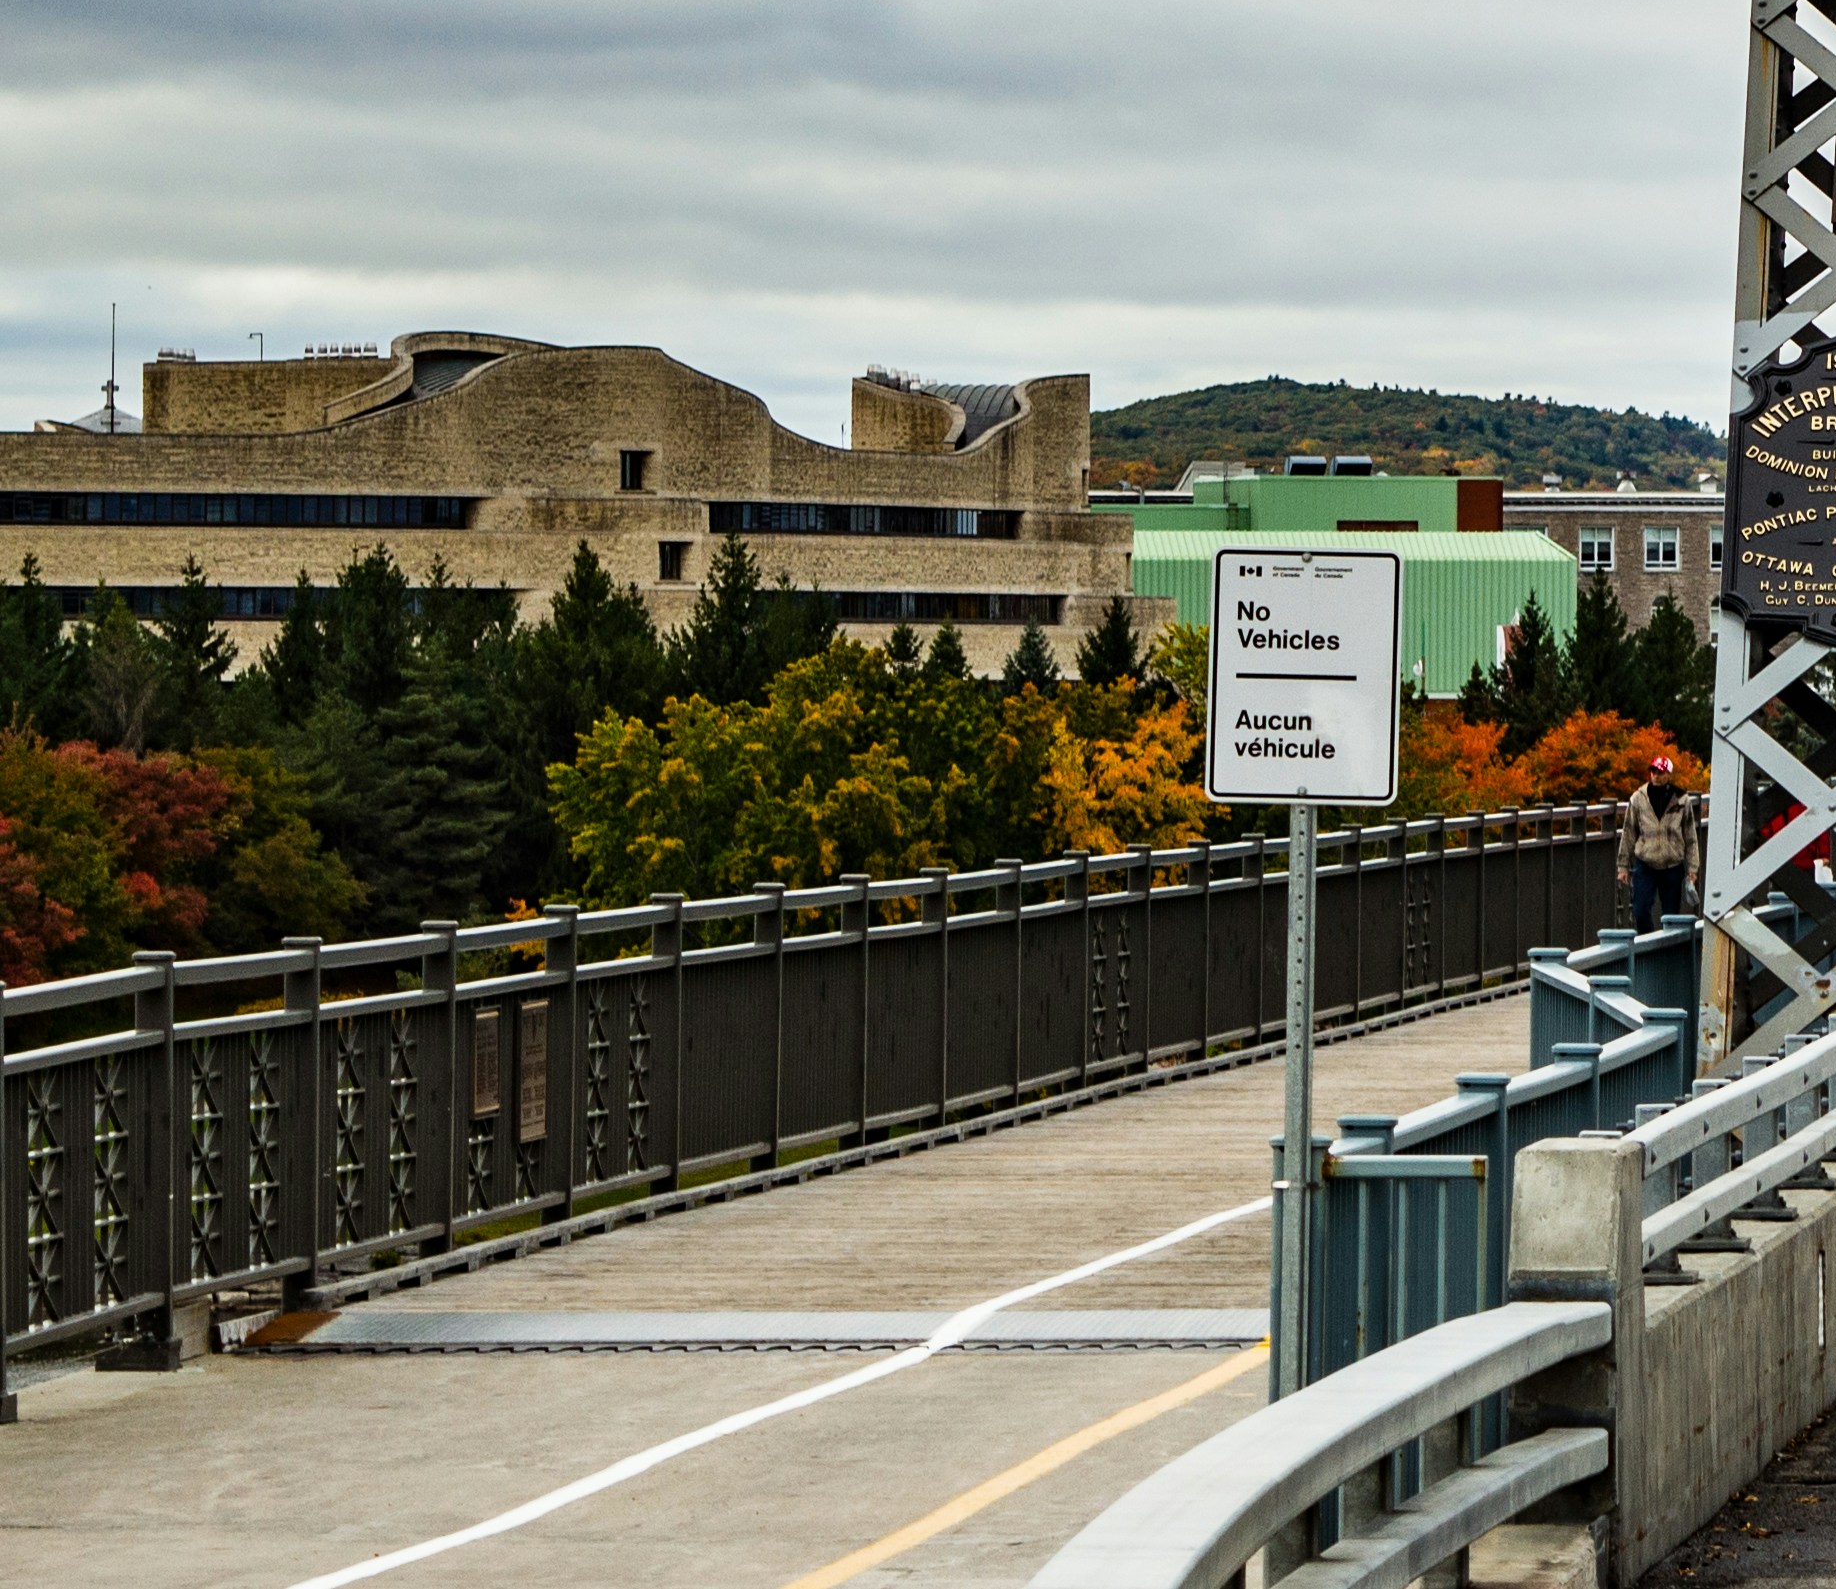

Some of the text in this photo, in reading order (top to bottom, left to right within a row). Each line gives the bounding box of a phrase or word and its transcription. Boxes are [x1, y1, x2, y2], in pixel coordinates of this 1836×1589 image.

[1745, 445, 1828, 480] DOMINION
[1741, 508, 1817, 541] PONTIAC
[1742, 551, 1813, 576] OTTAWA
[1237, 600, 1271, 622] No
[1237, 628, 1340, 650] Vehicles
[1235, 709, 1312, 731] Aucun
[1235, 737, 1336, 759] véhicule
